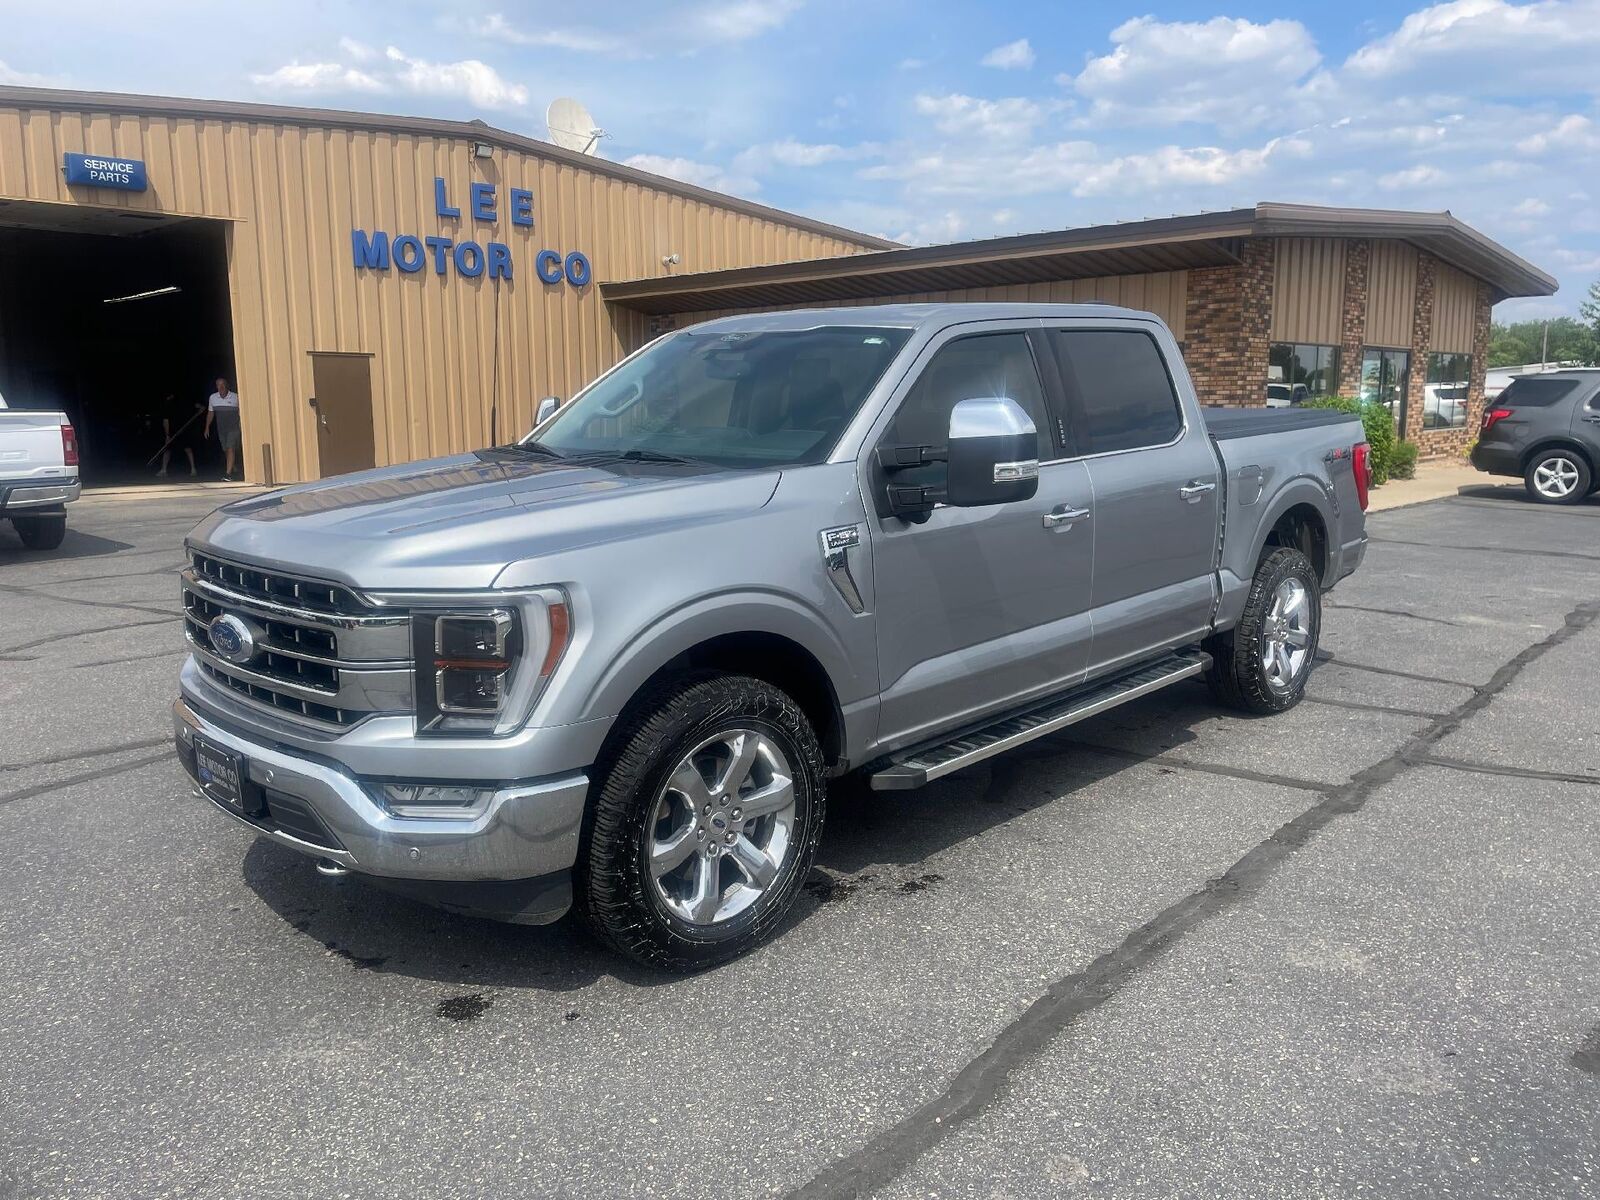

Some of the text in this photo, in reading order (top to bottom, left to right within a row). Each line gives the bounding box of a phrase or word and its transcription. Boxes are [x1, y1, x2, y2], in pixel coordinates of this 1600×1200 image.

[84, 158, 134, 174] SERVICE
[90, 170, 129, 184] PARTS
[434, 176, 534, 227] LEE
[352, 229, 591, 287] MOTOR CO
[206, 757, 227, 780] MOTOR
[227, 768, 238, 786] CO
